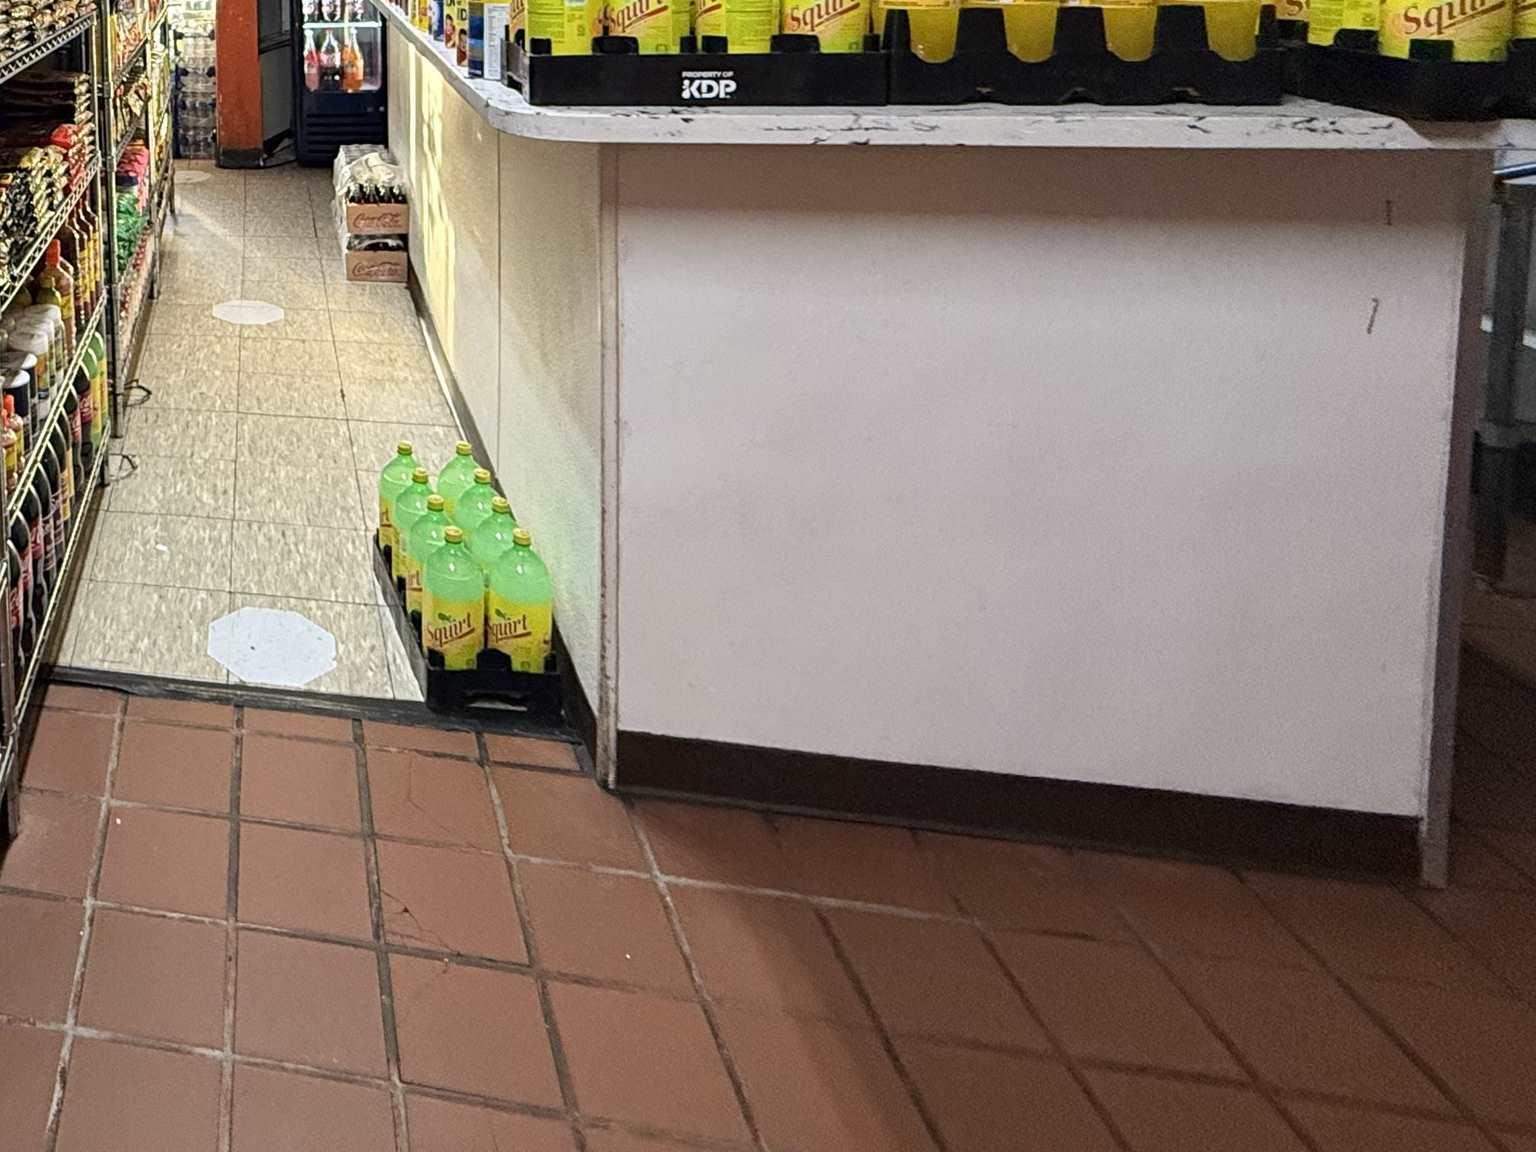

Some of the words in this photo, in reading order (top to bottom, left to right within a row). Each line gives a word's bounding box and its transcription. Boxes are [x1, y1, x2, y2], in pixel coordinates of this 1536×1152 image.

[681, 70, 721, 79] PROPERTY
[723, 70, 734, 78] OF
[681, 79, 737, 99] KDP
[426, 611, 473, 646] Squirt
